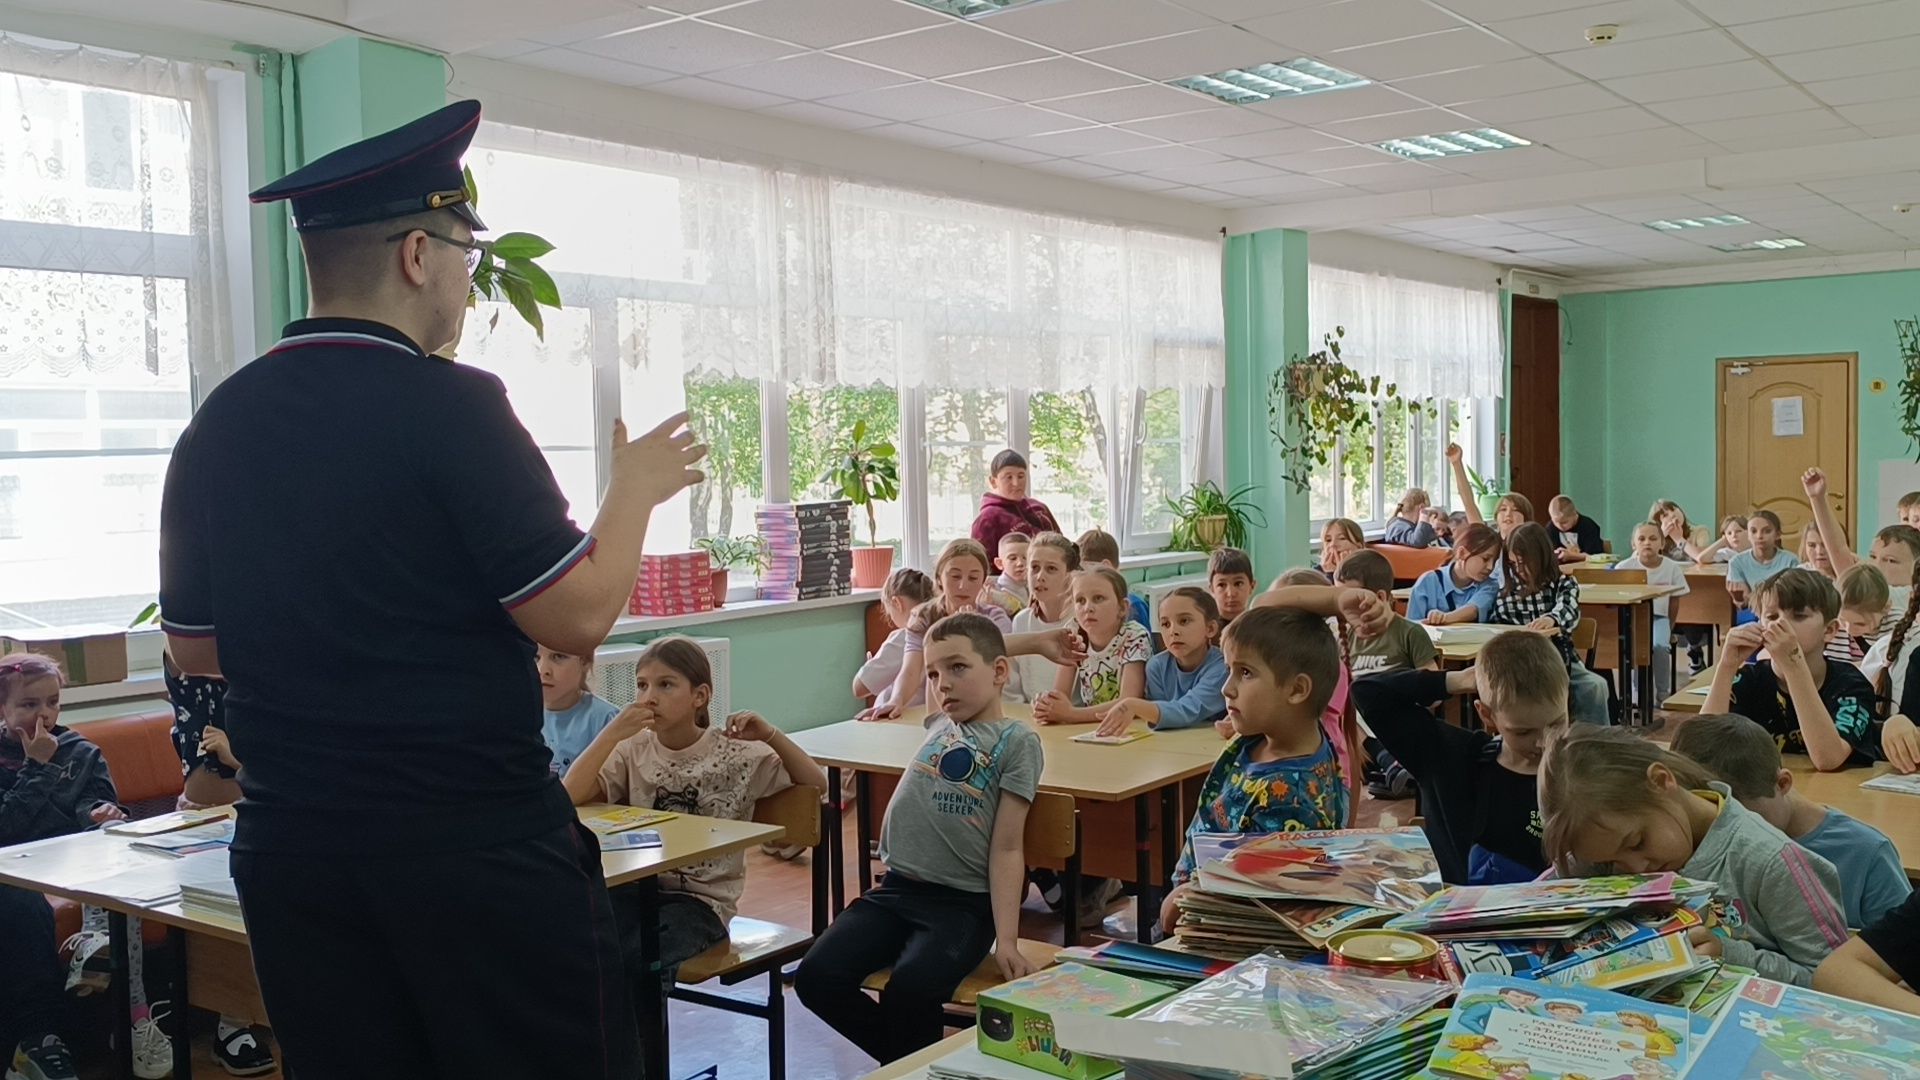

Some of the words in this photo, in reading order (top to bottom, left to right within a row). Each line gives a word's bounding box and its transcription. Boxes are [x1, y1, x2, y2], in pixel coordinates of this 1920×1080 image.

[1351, 655, 1388, 670] NIKE
[932, 791, 984, 809] ADVENTURE
[937, 802, 973, 816] SEEKER
